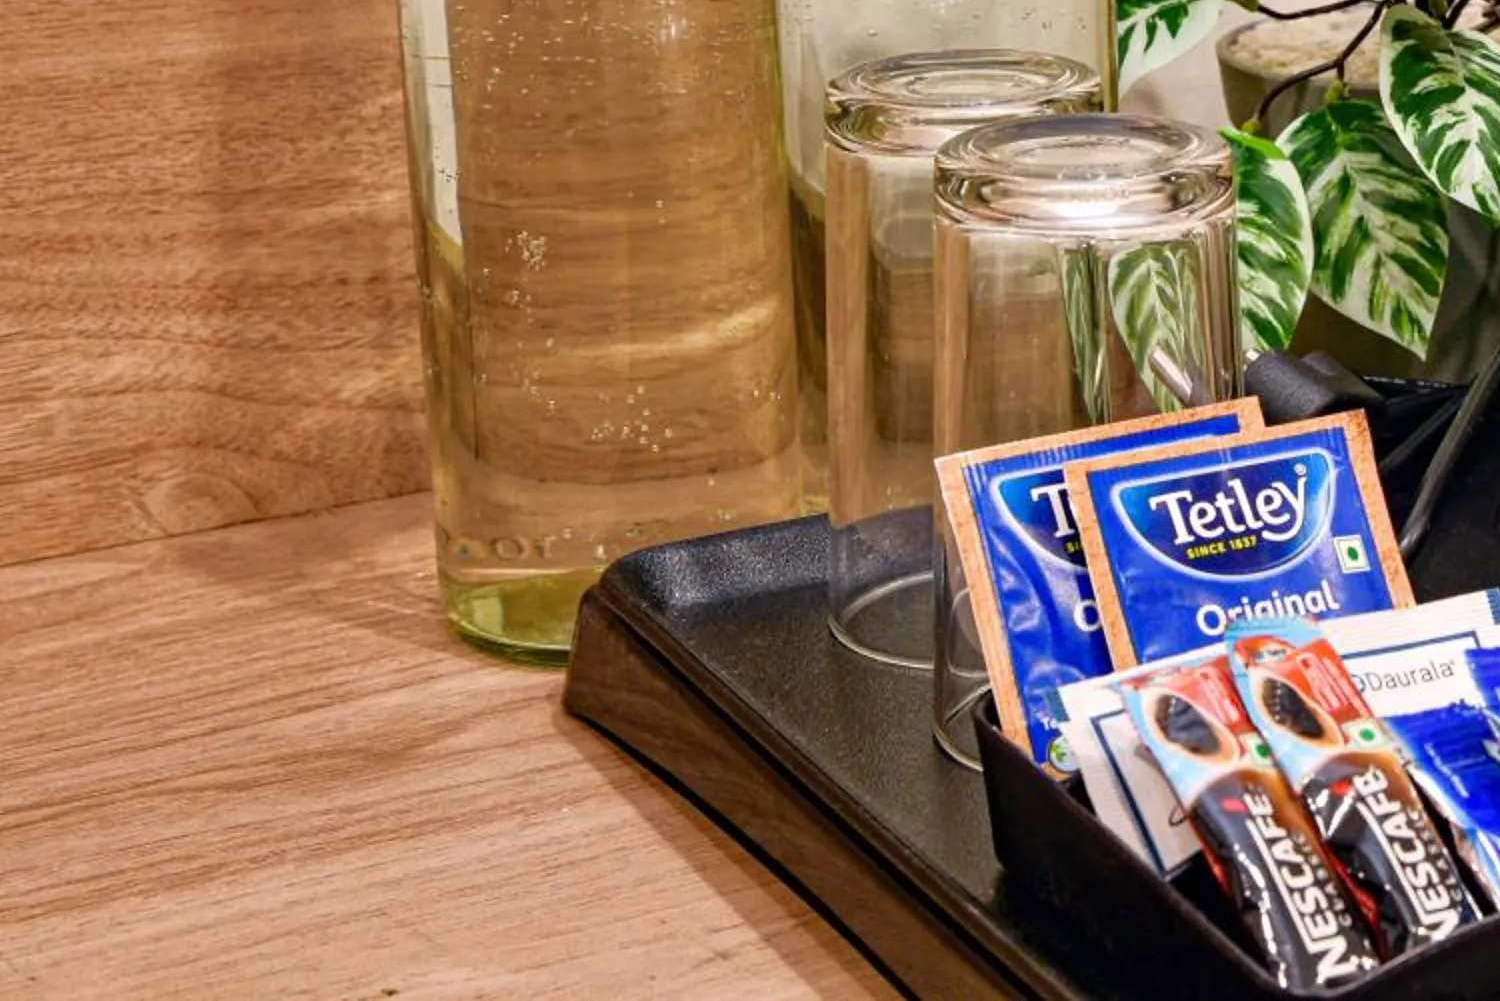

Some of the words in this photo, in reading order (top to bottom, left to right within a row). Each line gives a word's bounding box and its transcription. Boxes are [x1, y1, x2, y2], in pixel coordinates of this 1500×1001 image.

[1149, 475, 1307, 546] Tetley
[1186, 541, 1227, 560] SINCE
[1195, 578, 1341, 637] Original
